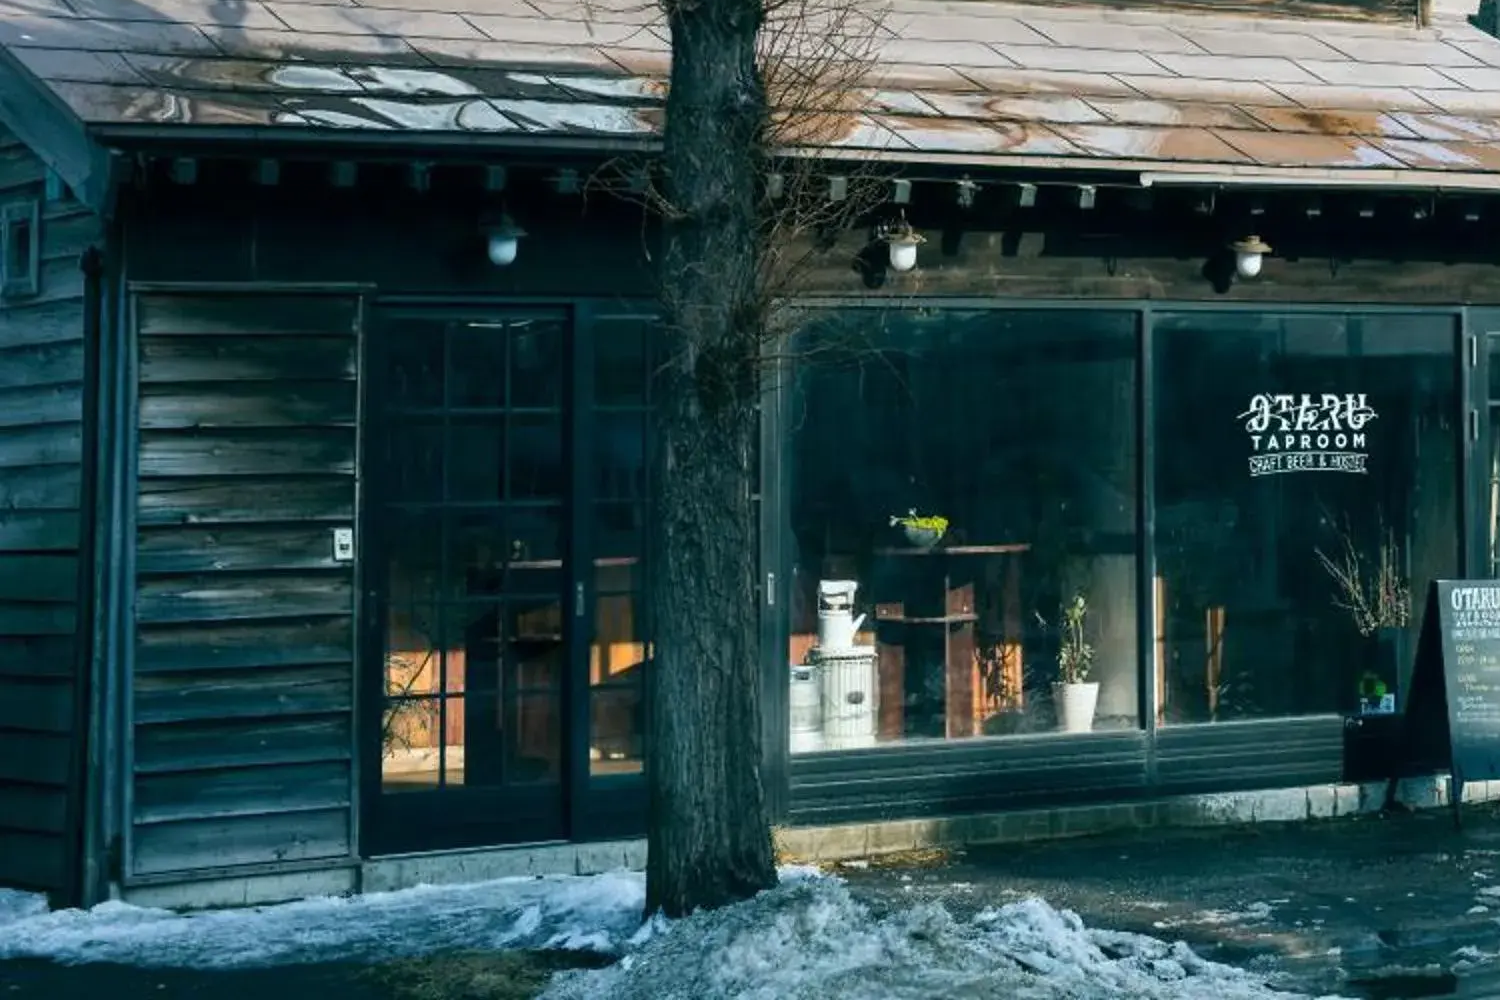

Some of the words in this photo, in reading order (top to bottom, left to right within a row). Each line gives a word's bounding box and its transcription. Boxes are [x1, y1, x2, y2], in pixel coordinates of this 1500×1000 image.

[1244, 392, 1376, 432] OTARU
[1250, 433, 1366, 450] TAPROOM
[1249, 455, 1282, 472] CRAFT
[1287, 454, 1314, 469] BEER
[1319, 454, 1327, 468] &
